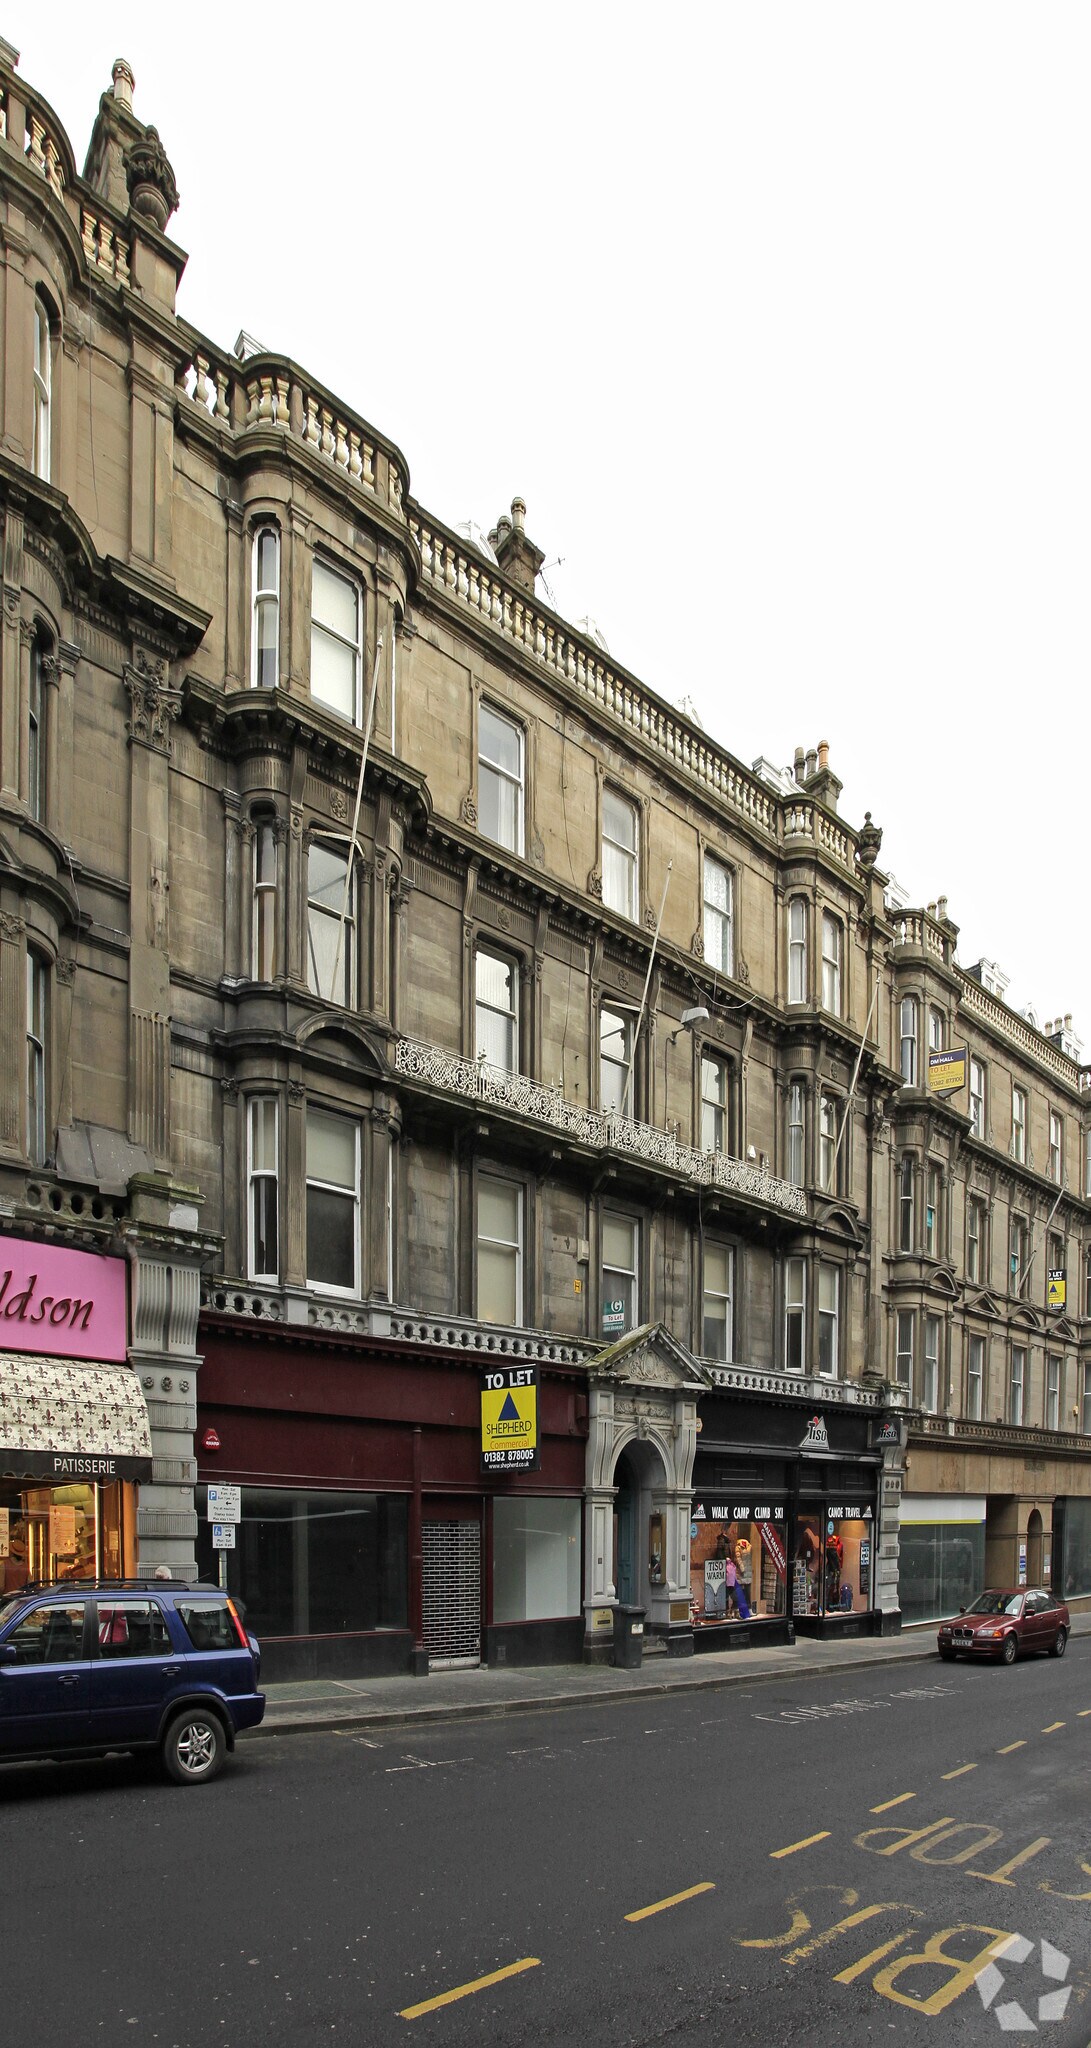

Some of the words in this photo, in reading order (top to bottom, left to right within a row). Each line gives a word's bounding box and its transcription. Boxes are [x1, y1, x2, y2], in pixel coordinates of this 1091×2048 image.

[485, 1373, 504, 1389] TO
[509, 1369, 533, 1387] LET
[486, 1421, 532, 1434] SHEPHERD
[490, 1438, 530, 1450] Commercial
[484, 1451, 505, 1463] 01382
[508, 1449, 534, 1461] 878005
[54, 1458, 116, 1474] PATISSERIE
[712, 1506, 728, 1518] WALK
[733, 1507, 750, 1519] CAMP
[754, 1507, 771, 1519] CLIMB
[774, 1507, 784, 1519] SKI
[828, 1507, 843, 1518] CANOE
[845, 1507, 860, 1518] TRAVEL
[763, 1522, 772, 1539] SALE
[770, 1537, 779, 1554] SALE
[777, 1552, 786, 1569] SALE
[708, 1562, 723, 1571] TISO
[706, 1572, 725, 1580] WARM
[730, 1884, 1022, 2016] BUS
